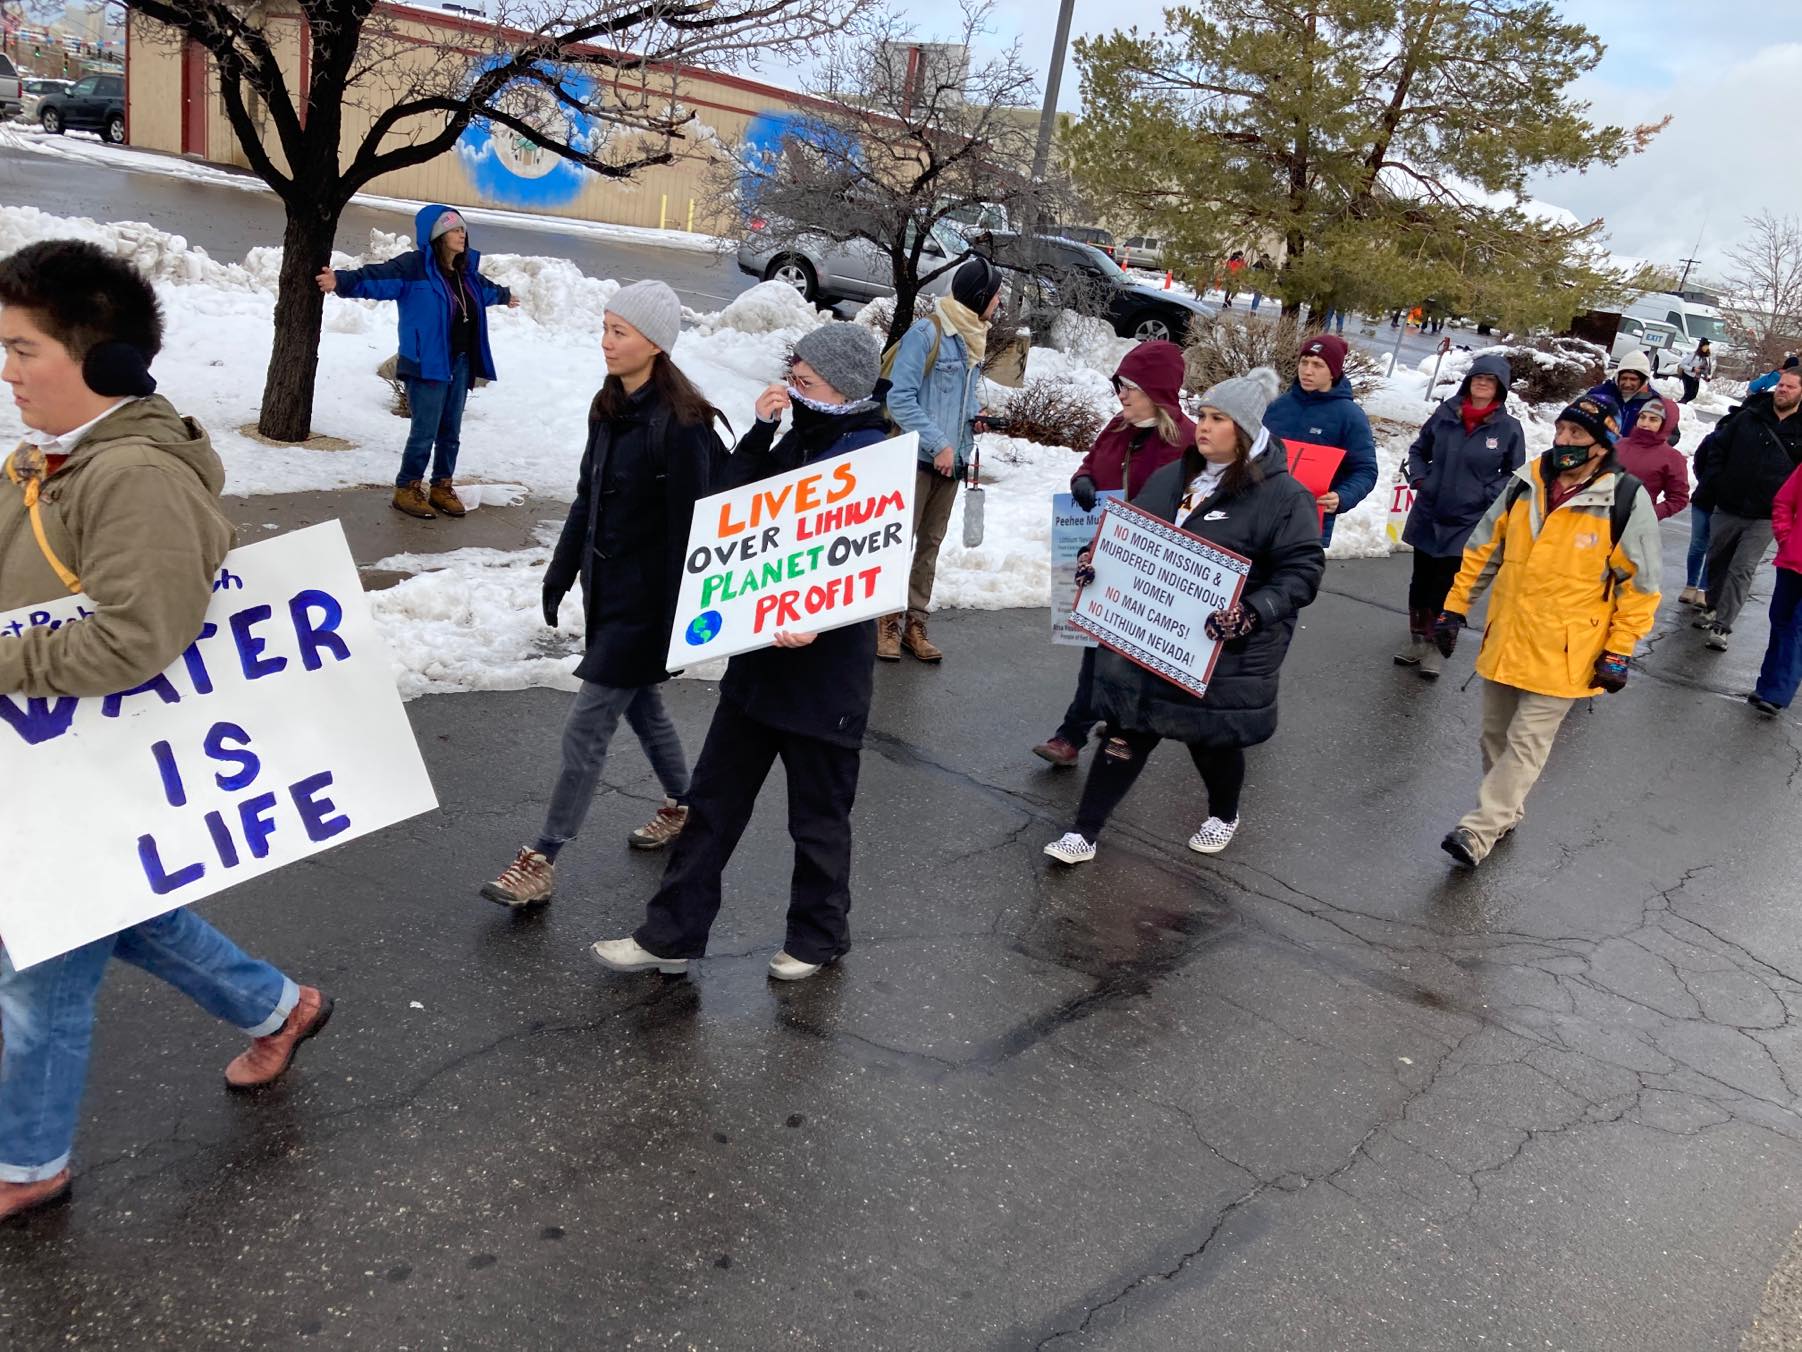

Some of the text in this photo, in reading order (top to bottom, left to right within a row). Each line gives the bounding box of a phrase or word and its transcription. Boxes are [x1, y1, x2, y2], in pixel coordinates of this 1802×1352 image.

[1646, 333, 1664, 343] EXIT
[717, 462, 857, 539] LIVES
[1055, 515, 1085, 527] Peehee
[686, 526, 781, 575] OVER
[700, 522, 903, 610] PLANET OVER
[1100, 538, 1226, 611] MURDERED INDIGENOUS
[1114, 524, 1222, 587] NO MORE MISSING &
[753, 565, 882, 634] PROFIT
[1105, 586, 1191, 640] NO MAN CAMPS!
[1133, 576, 1175, 608] WOMEN
[1088, 600, 1195, 668] NO LITHIUM NEVADA!
[151, 721, 261, 807] IS
[137, 770, 352, 895] LIFE
